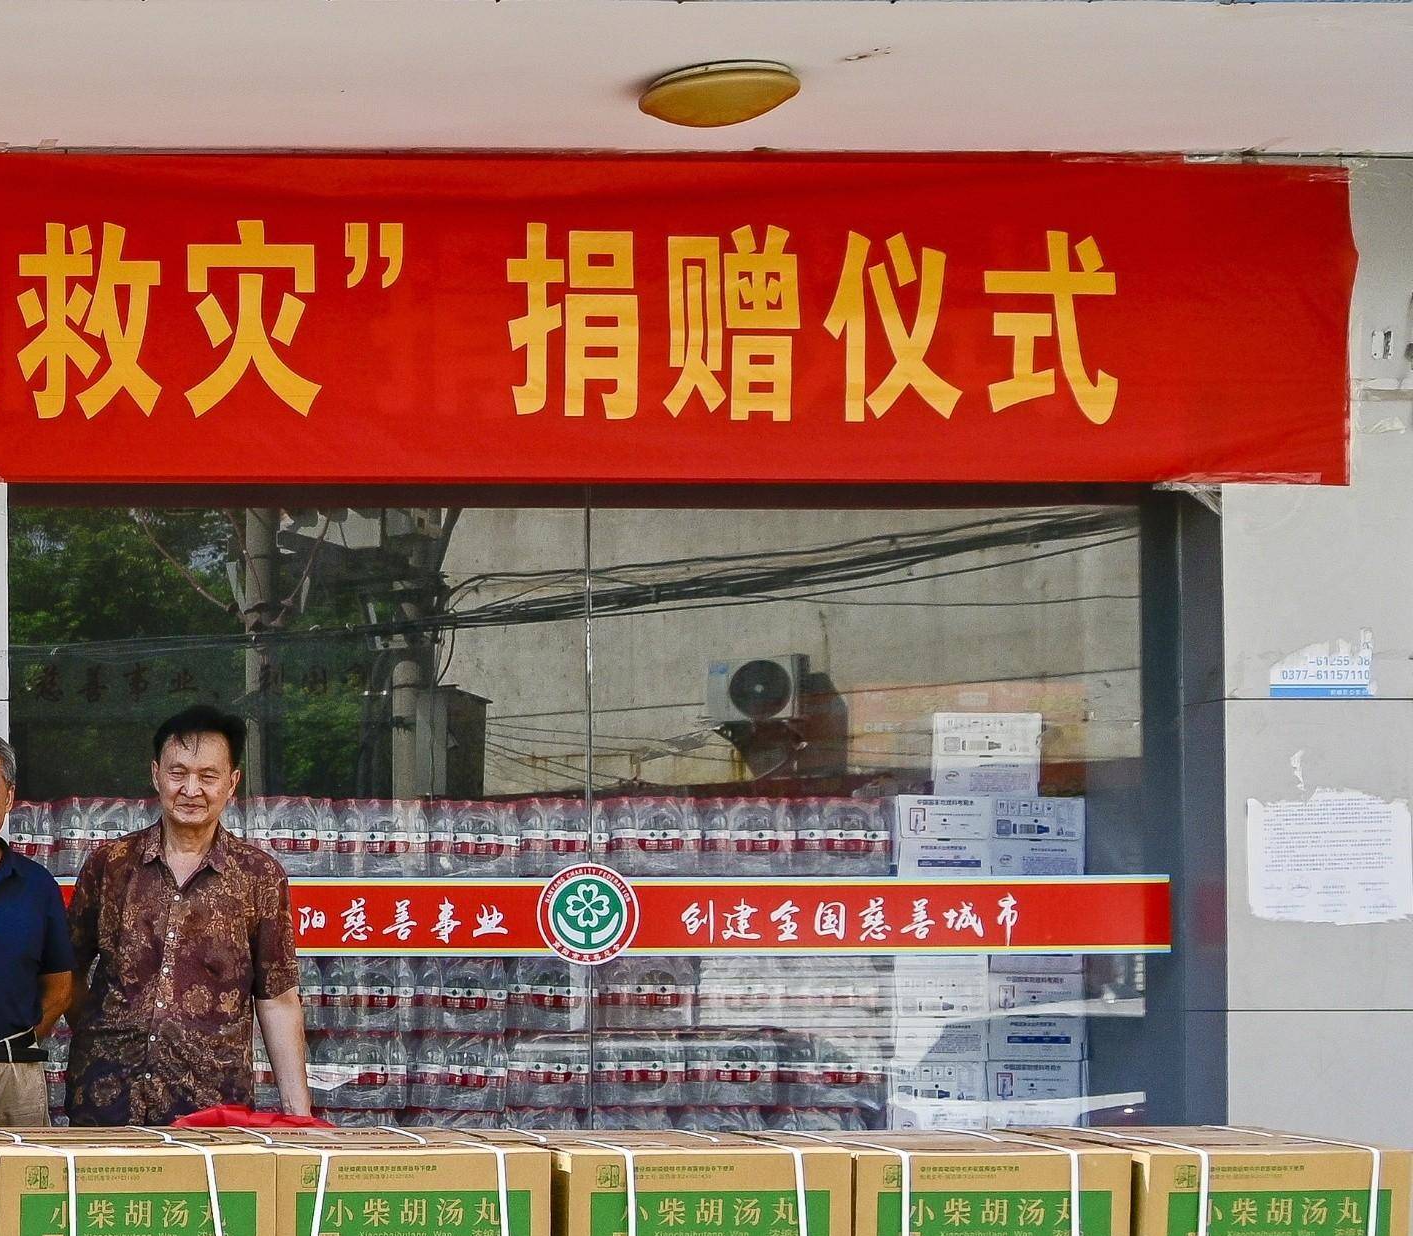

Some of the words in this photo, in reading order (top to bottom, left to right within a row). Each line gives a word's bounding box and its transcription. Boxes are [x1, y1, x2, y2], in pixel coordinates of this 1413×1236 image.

[506, 222, 1119, 425] 捐赠仪式
[681, 893, 1022, 947] 创建全国慈善城市
[50, 1199, 226, 1229] 小柴胡汤丸
[325, 1197, 498, 1227] 小柴胡汤丸
[912, 1198, 1082, 1227] 小柴胡汤丸
[1209, 1197, 1363, 1226] 小柴胡汤丸
